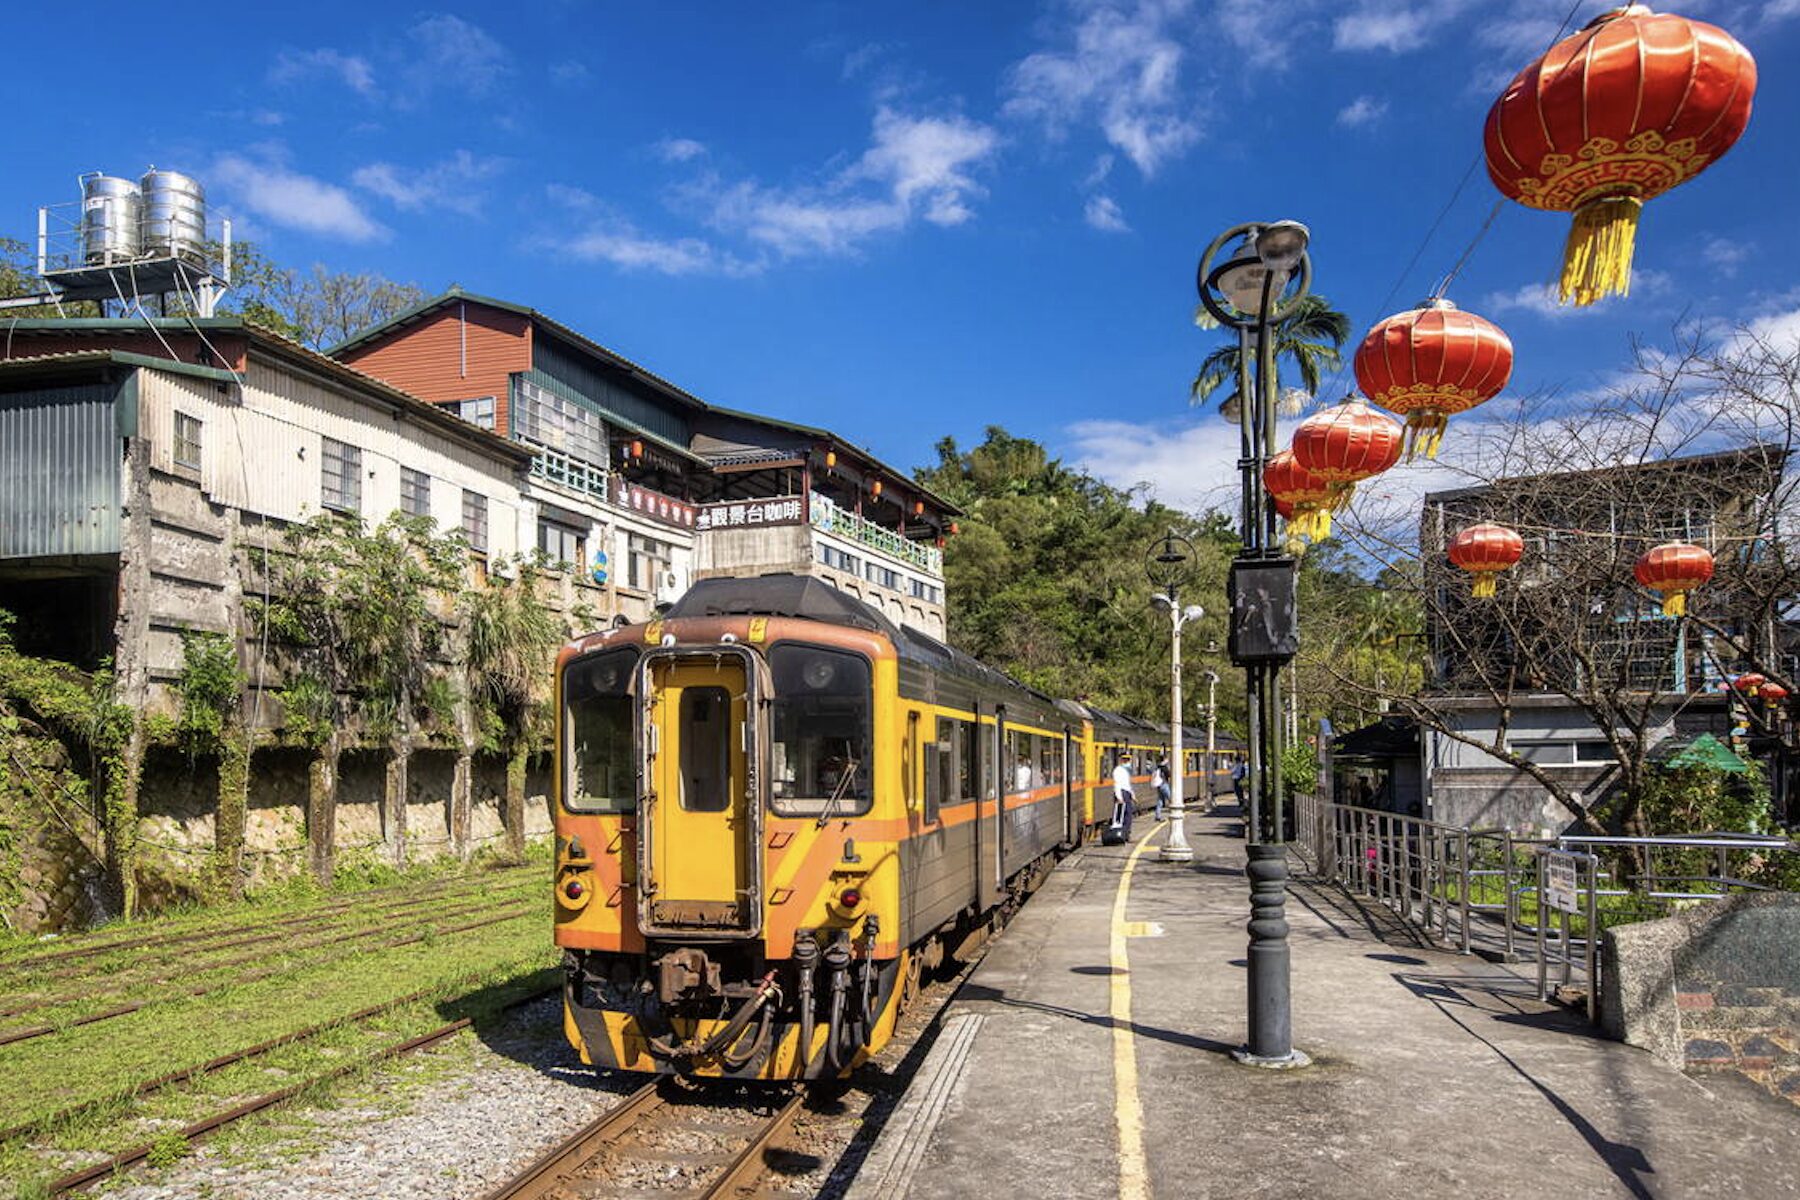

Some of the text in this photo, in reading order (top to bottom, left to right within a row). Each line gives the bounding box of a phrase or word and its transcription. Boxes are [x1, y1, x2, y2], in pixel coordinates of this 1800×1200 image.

[711, 501, 801, 526] 觀景台咖啡
